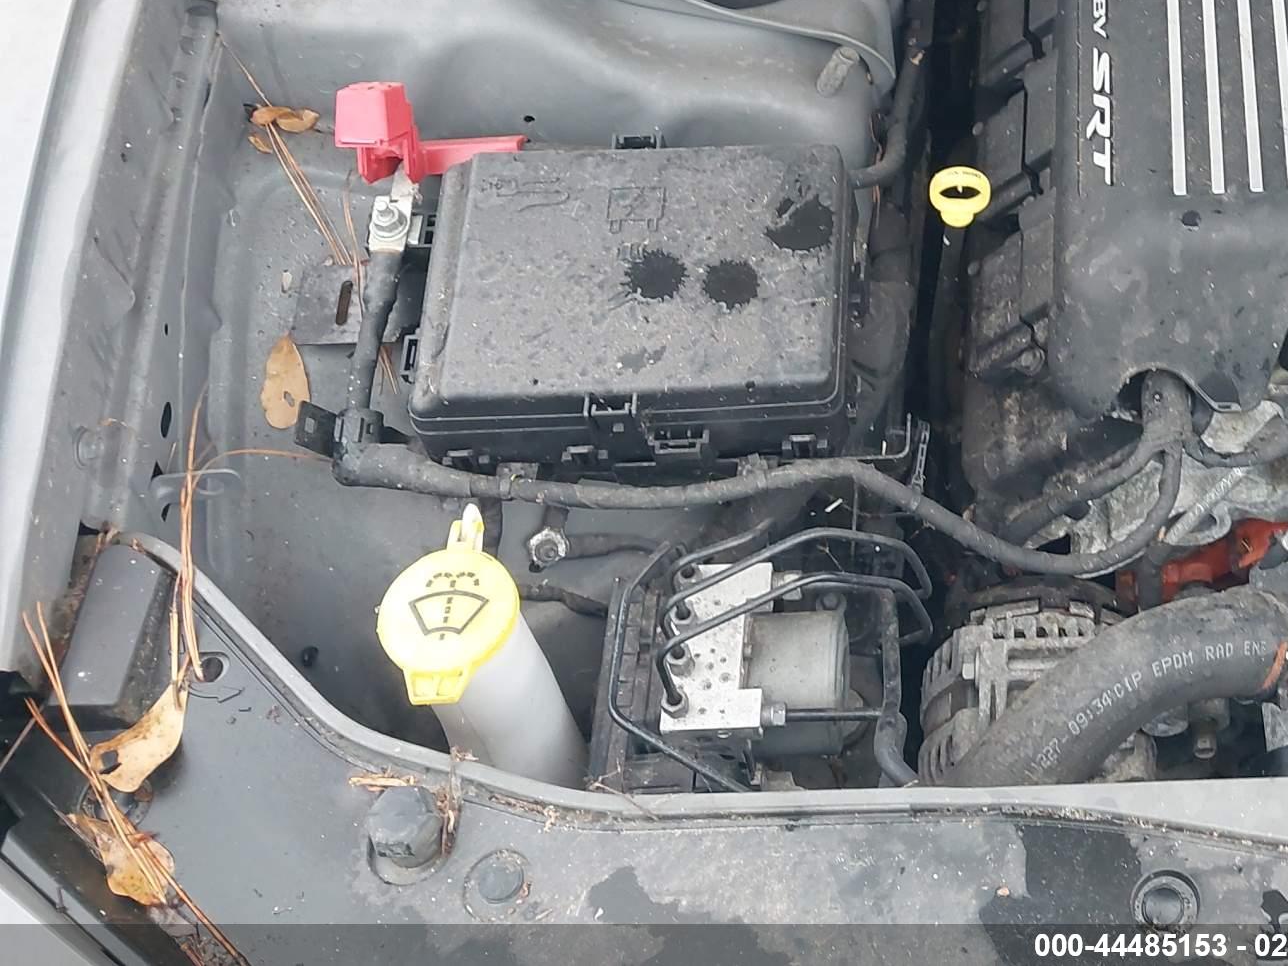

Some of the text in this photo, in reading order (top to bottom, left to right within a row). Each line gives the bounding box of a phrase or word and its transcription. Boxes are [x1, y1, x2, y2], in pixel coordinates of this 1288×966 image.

[1086, 47, 1111, 185] SRT
[1151, 649, 1194, 678] EPDM
[1205, 642, 1233, 662] RAD
